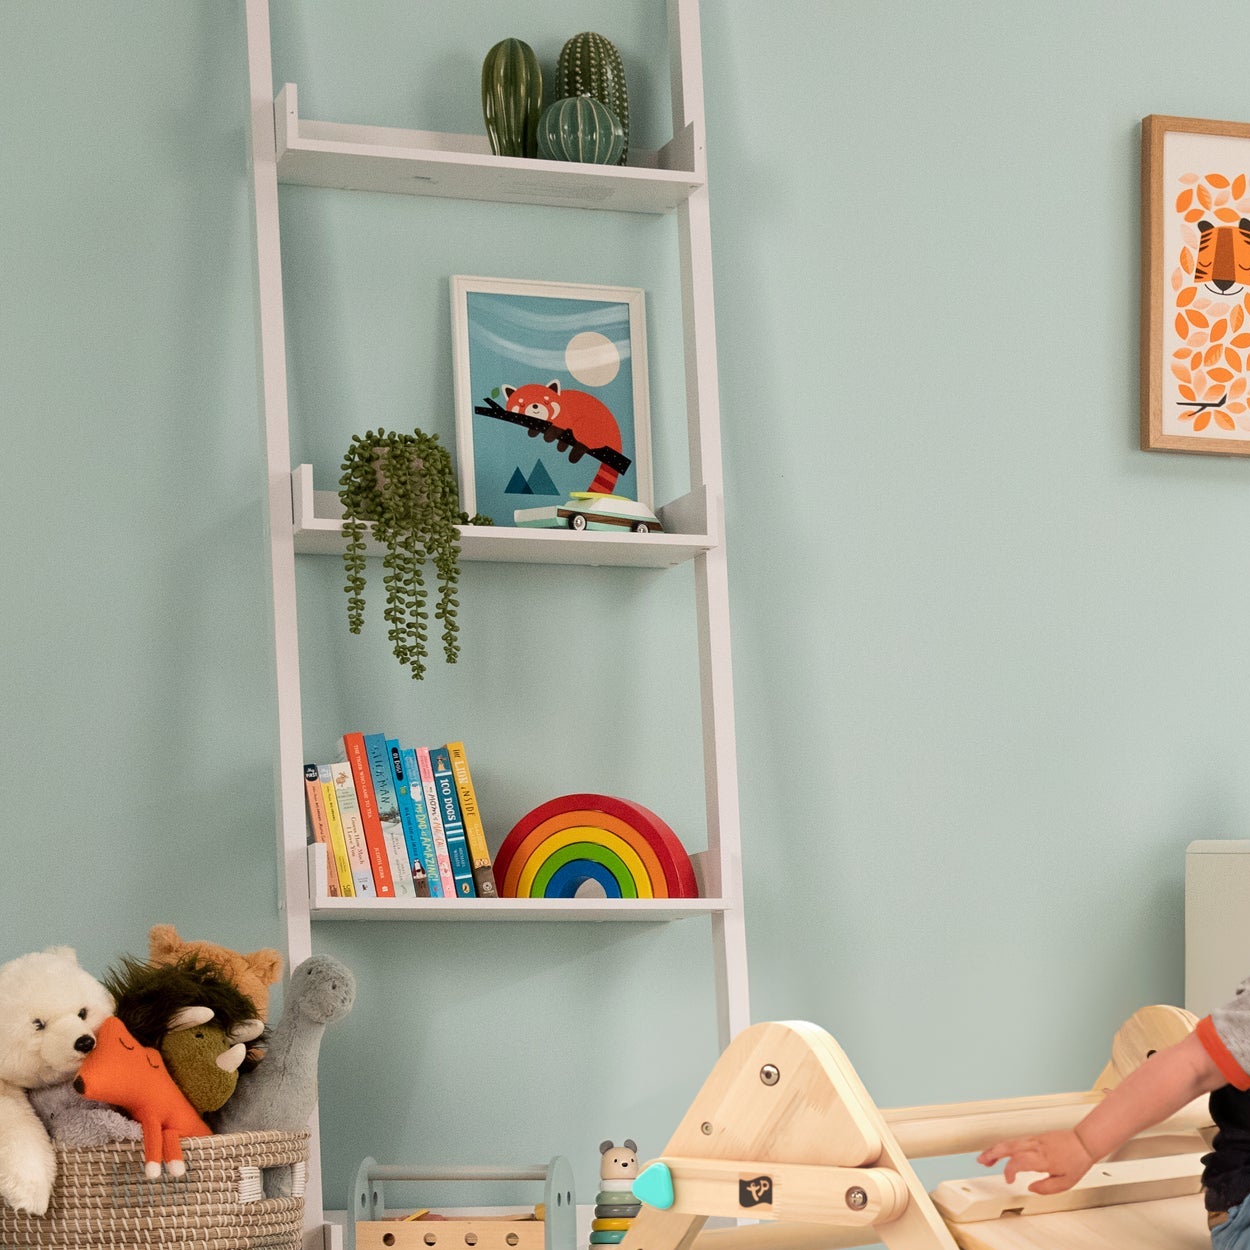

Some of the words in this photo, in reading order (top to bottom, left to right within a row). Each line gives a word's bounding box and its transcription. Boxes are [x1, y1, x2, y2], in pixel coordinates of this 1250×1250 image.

[440, 779, 450, 795] 100
[444, 798, 456, 821] DOGS
[420, 836, 438, 882] AMAZING!
